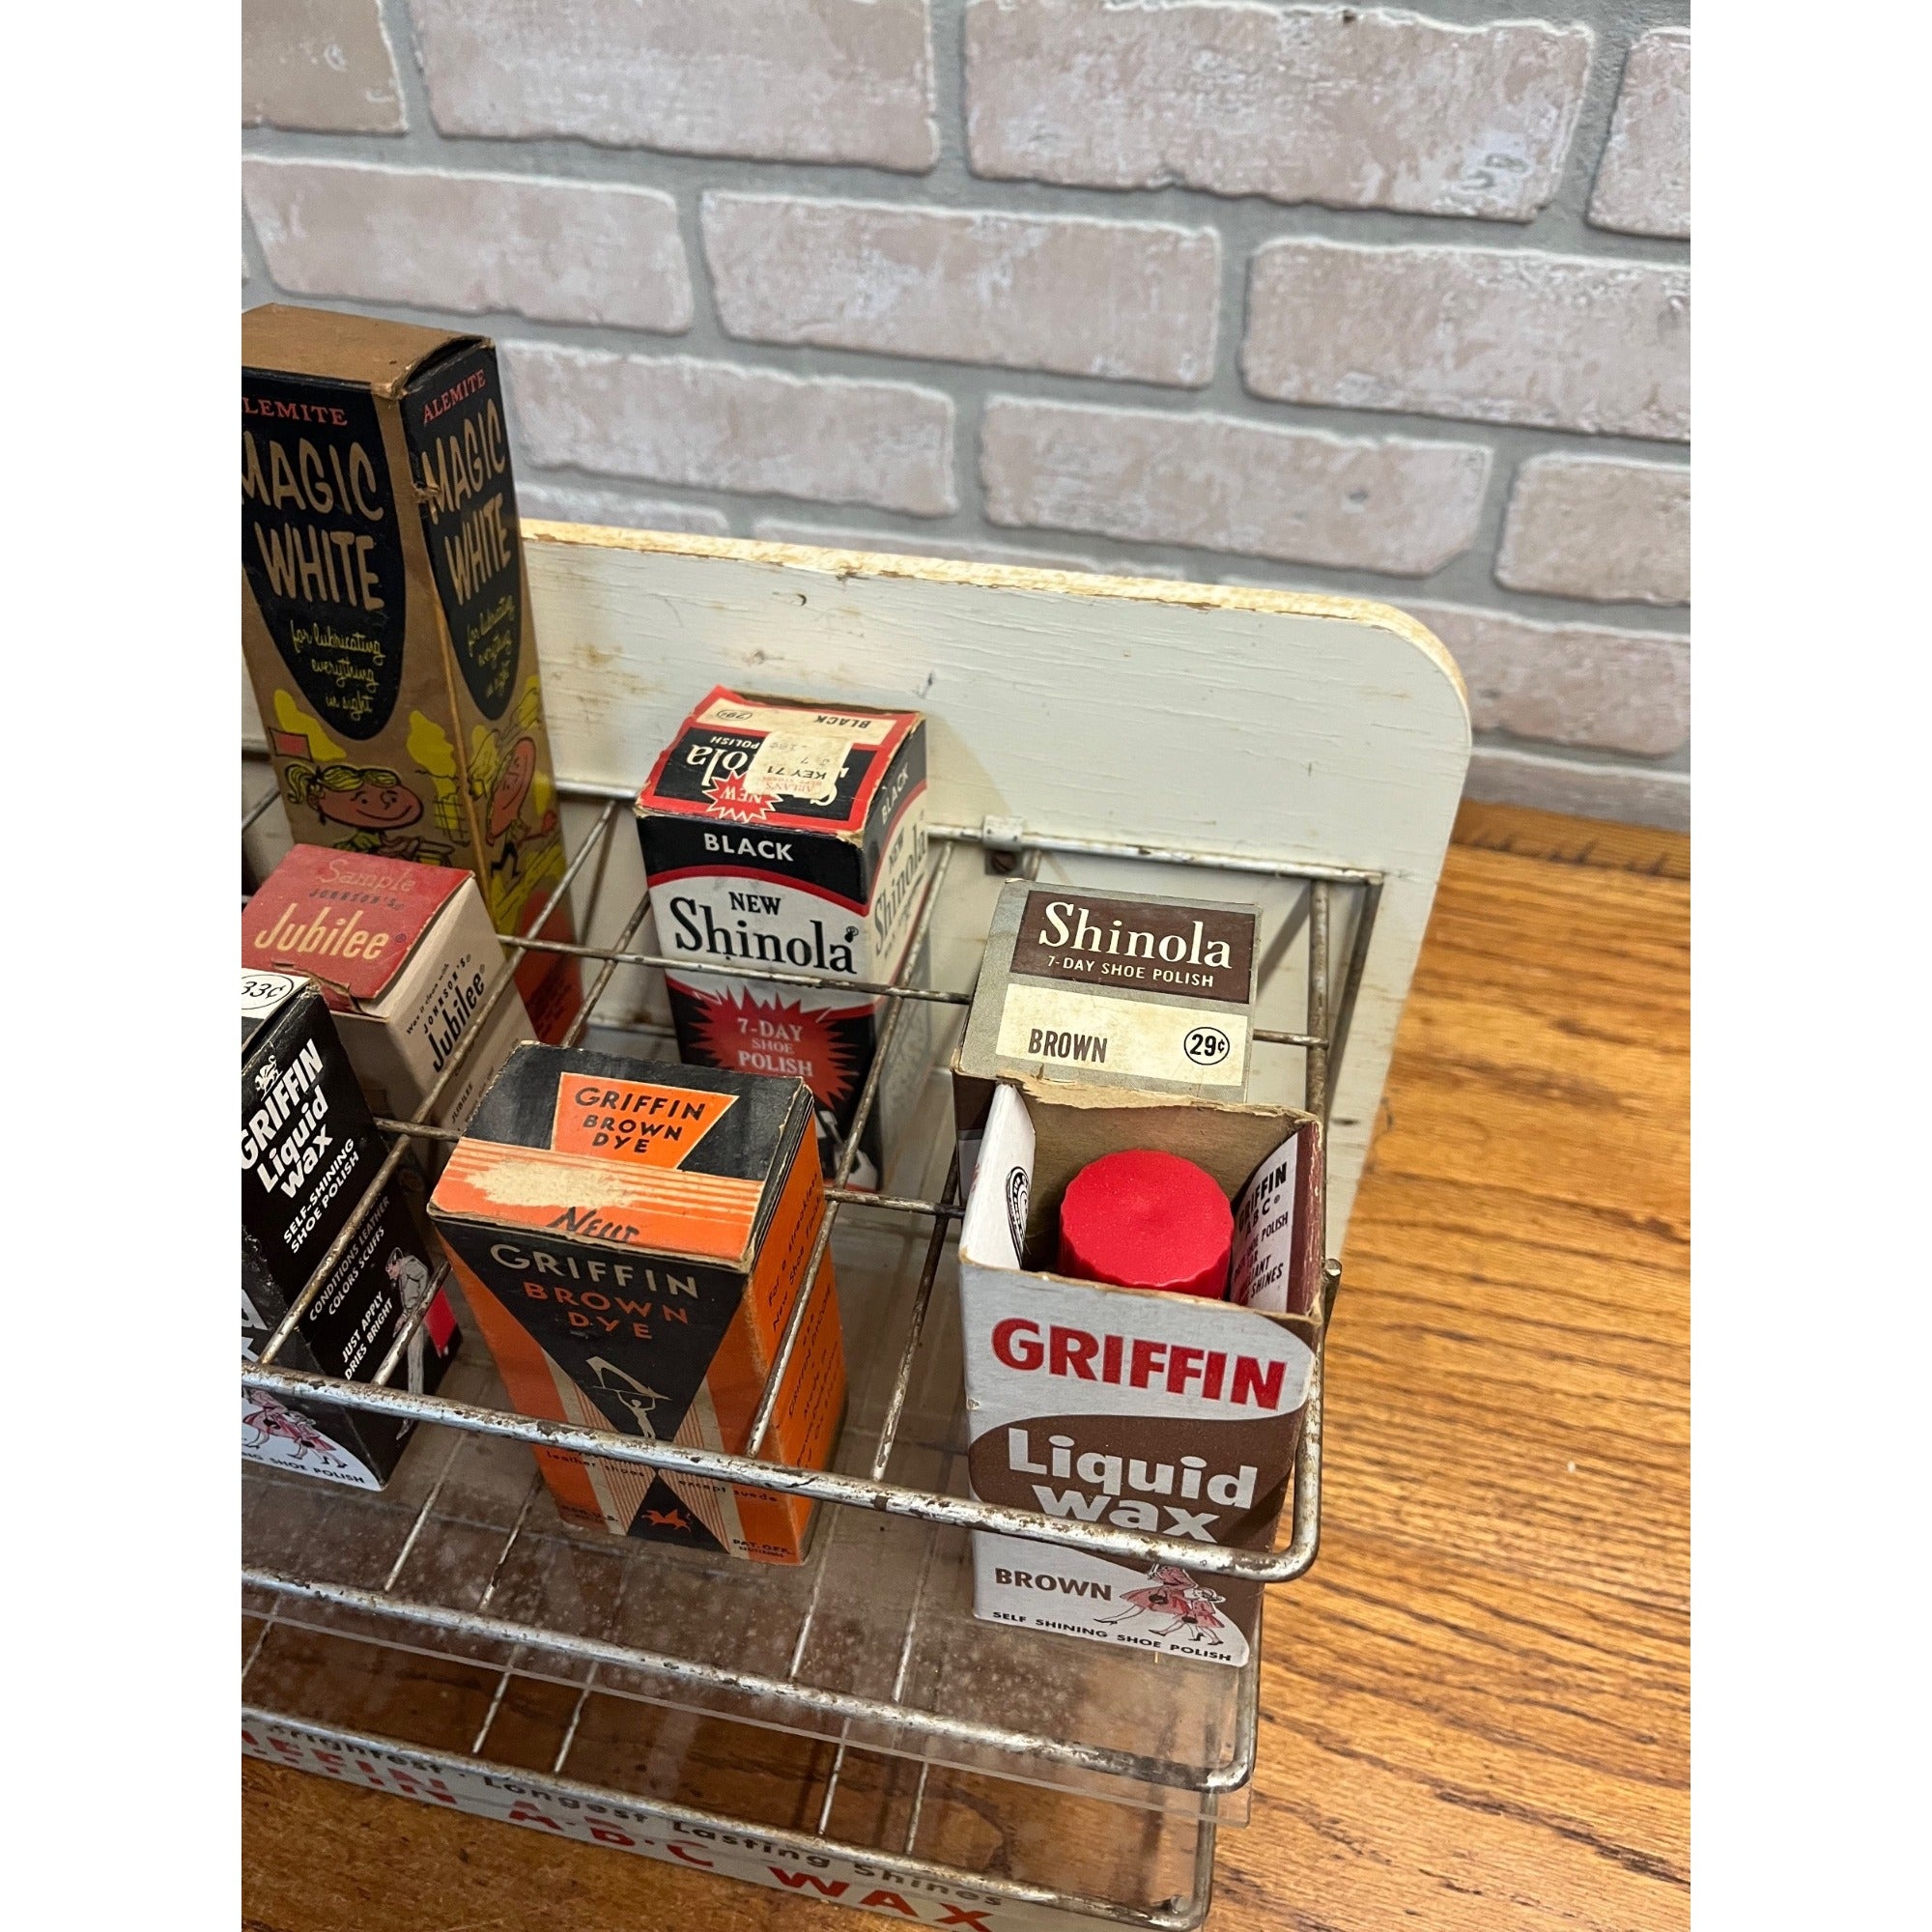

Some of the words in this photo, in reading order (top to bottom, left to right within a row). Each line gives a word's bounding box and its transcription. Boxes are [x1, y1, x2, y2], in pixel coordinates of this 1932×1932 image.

[423, 368, 486, 425] ALEMITE
[421, 398, 505, 525] MAGIC
[254, 523, 384, 611] WHITE
[444, 493, 511, 606] WHITE
[290, 619, 312, 654] for
[313, 622, 385, 666] lubricating
[311, 659, 379, 694] everything
[710, 736, 760, 750] POLISH
[813, 714, 871, 729] BLACK
[768, 766, 784, 776] 71
[791, 769, 827, 780] KEY
[881, 762, 909, 824] BLACK
[704, 833, 794, 862] BLACK
[316, 858, 416, 893] Sample
[874, 824, 926, 956] Shinola
[728, 892, 781, 916] NEW
[254, 902, 390, 960] Jubilee
[669, 896, 857, 974] Shinola
[1038, 901, 1232, 970] Shinola
[1047, 954, 1095, 972] 7-DAY
[1101, 962, 1146, 980] SHOE
[1152, 969, 1214, 988] POLISH
[428, 973, 485, 1073] Jubilee
[737, 1017, 804, 1042] 7-DAY
[752, 1037, 794, 1054] SHOE
[1028, 1028, 1108, 1064] BROWN
[1189, 1033, 1226, 1058] 29¢
[738, 1051, 813, 1077] POLISH
[242, 1037, 324, 1171] GRIFFIN
[574, 1086, 705, 1122] GRIFFIN
[582, 1114, 683, 1141] BROWN
[256, 1084, 328, 1194] Liquid
[280, 1124, 332, 1199] wax
[592, 1132, 649, 1154] DYE
[283, 1138, 355, 1245] SELF-SHINING
[291, 1209, 323, 1254] SHOE
[322, 1151, 359, 1208] POLISH
[1261, 1210, 1290, 1242] POLISH
[309, 1243, 359, 1322] CONDITIONS
[358, 1195, 390, 1246] LEATHER
[327, 1269, 359, 1316] COLORS
[358, 1225, 385, 1269] SCUFFS
[490, 1243, 698, 1299] GRIFFIN
[1251, 1263, 1284, 1297] SHINES
[342, 1329, 361, 1363] JUST
[361, 1291, 384, 1329] APPLY
[523, 1281, 689, 1324] BROWN
[568, 1312, 654, 1340] DYE
[344, 1344, 367, 1381] DRIES
[366, 1297, 394, 1344] BRIGHT
[990, 1318, 1288, 1411] GRIFFIN
[270, 1457, 308, 1471] SHOE
[313, 1467, 365, 1484] POLISH
[546, 1450, 596, 1467] leather
[605, 1464, 644, 1477] shoes
[733, 1490, 777, 1502] suede
[1008, 1428, 1258, 1509] Liquid
[1031, 1484, 1220, 1544] wax
[995, 1567, 1112, 1601] BROWN
[992, 1610, 1027, 1624] SELF
[1036, 1618, 1108, 1639] SHINING
[1117, 1634, 1162, 1650] SHOE
[1170, 1643, 1232, 1662] POLISH
[484, 1776, 648, 1824] Longest
[673, 1821, 830, 1869] Lasting
[854, 1861, 1003, 1906] Shines
[767, 1866, 994, 1932] WAX
